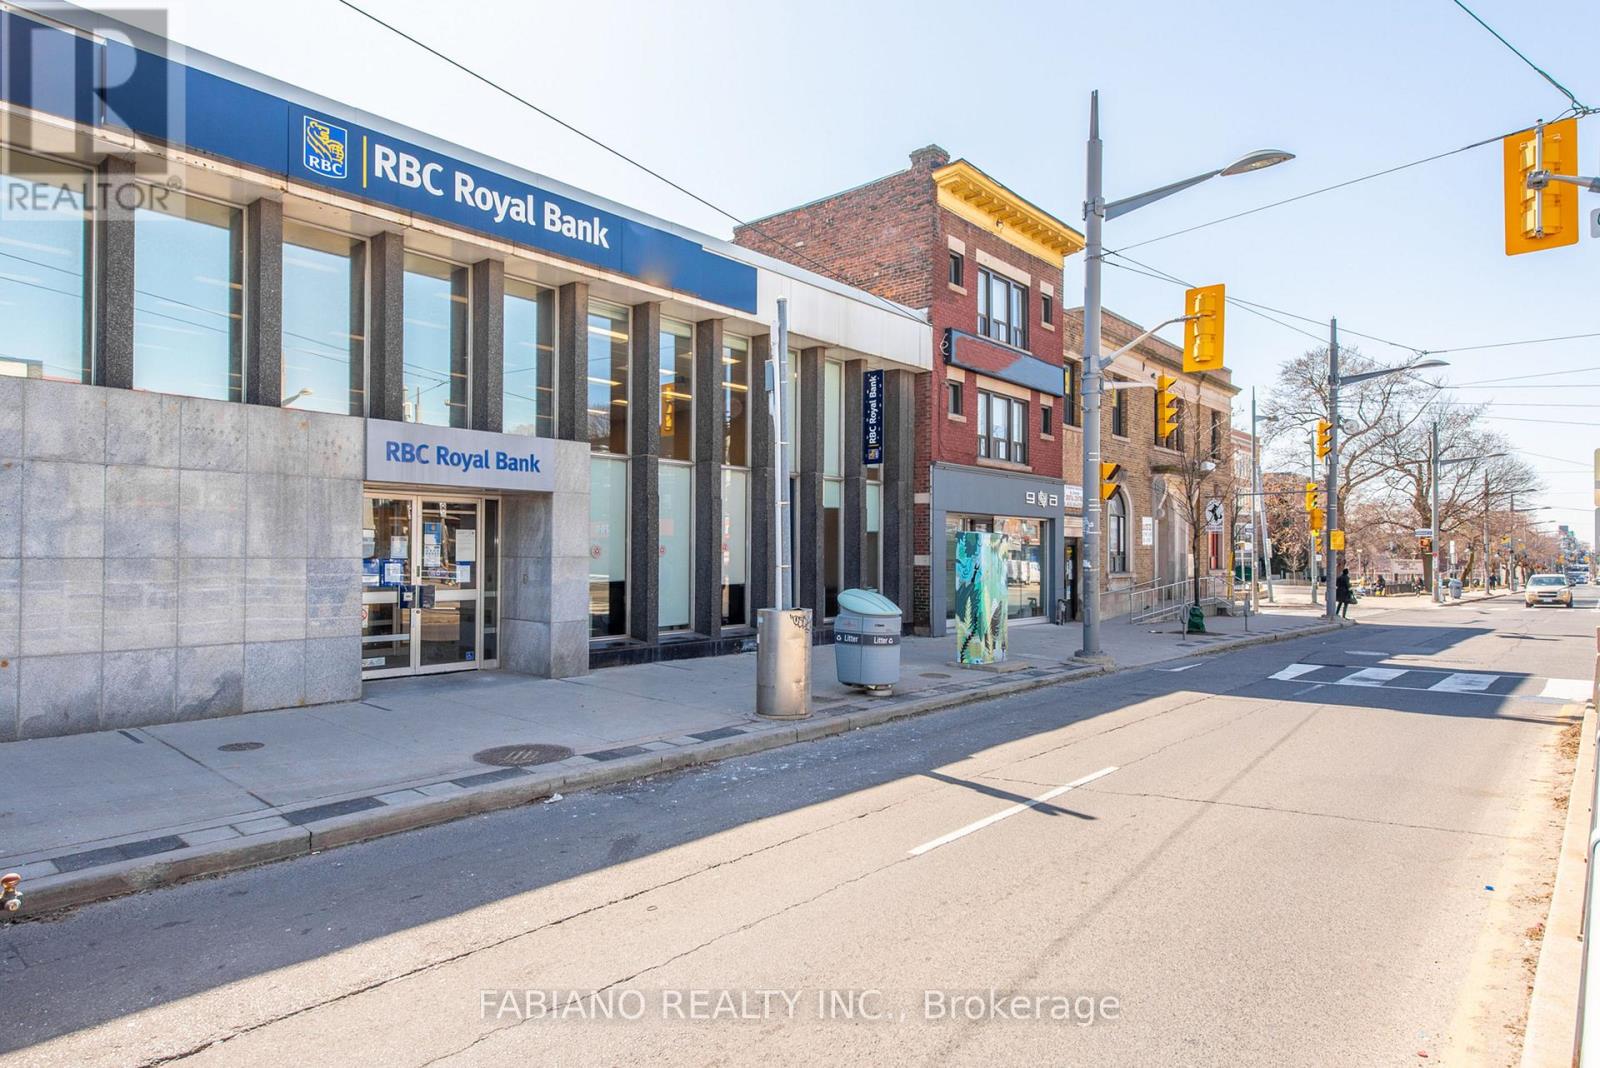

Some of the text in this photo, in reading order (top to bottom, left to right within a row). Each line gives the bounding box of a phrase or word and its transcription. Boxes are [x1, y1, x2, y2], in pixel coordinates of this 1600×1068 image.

[309, 155, 343, 176] RBC
[374, 143, 610, 249] RBC Royal Bank
[868, 375, 879, 444] RBC Royal Bank
[386, 441, 541, 473] RBC Royal Bank
[844, 634, 859, 643] Litter
[873, 636, 888, 645] Litter
